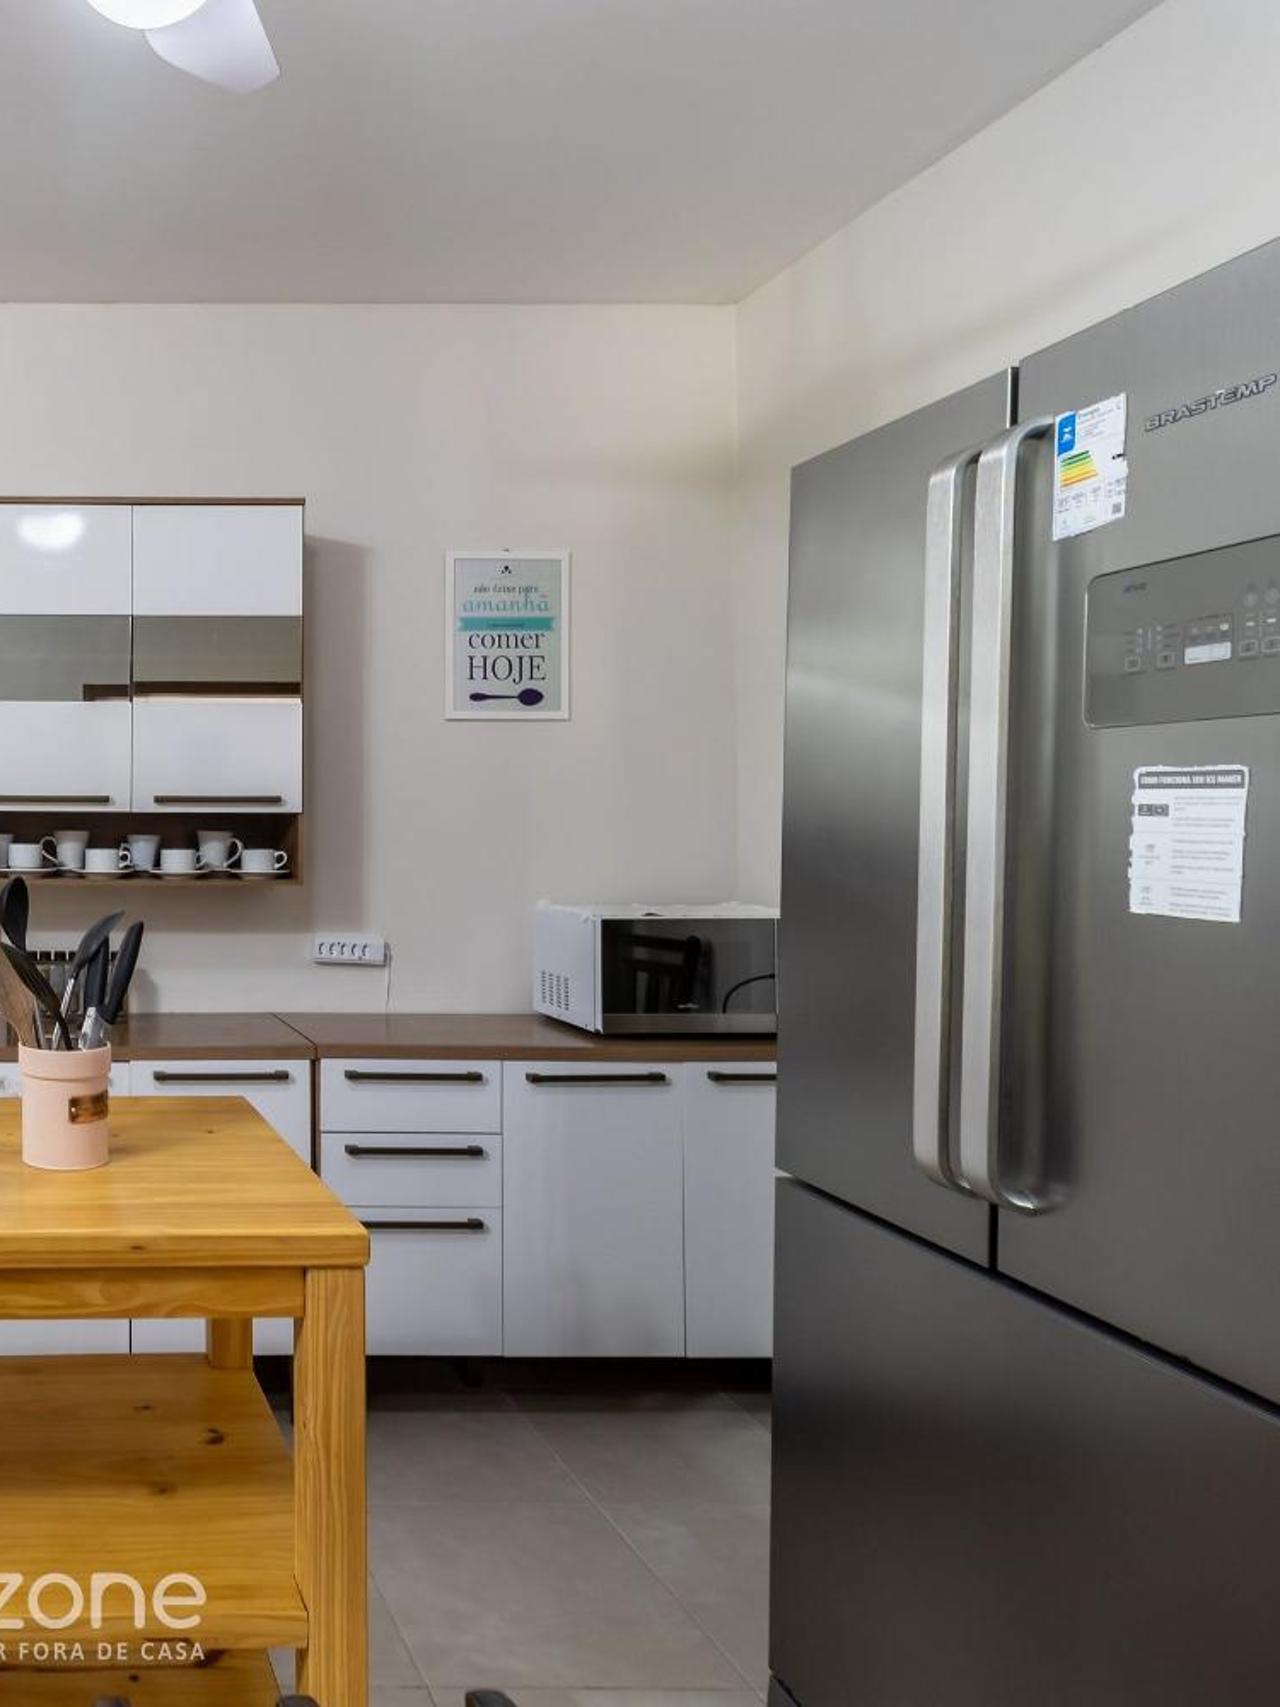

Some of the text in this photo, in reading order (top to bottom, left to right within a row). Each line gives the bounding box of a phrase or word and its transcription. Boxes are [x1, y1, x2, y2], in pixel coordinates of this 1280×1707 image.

[1144, 373, 1278, 432] BRASTEMP
[468, 632, 546, 650] comer
[467, 655, 547, 685] HOJE
